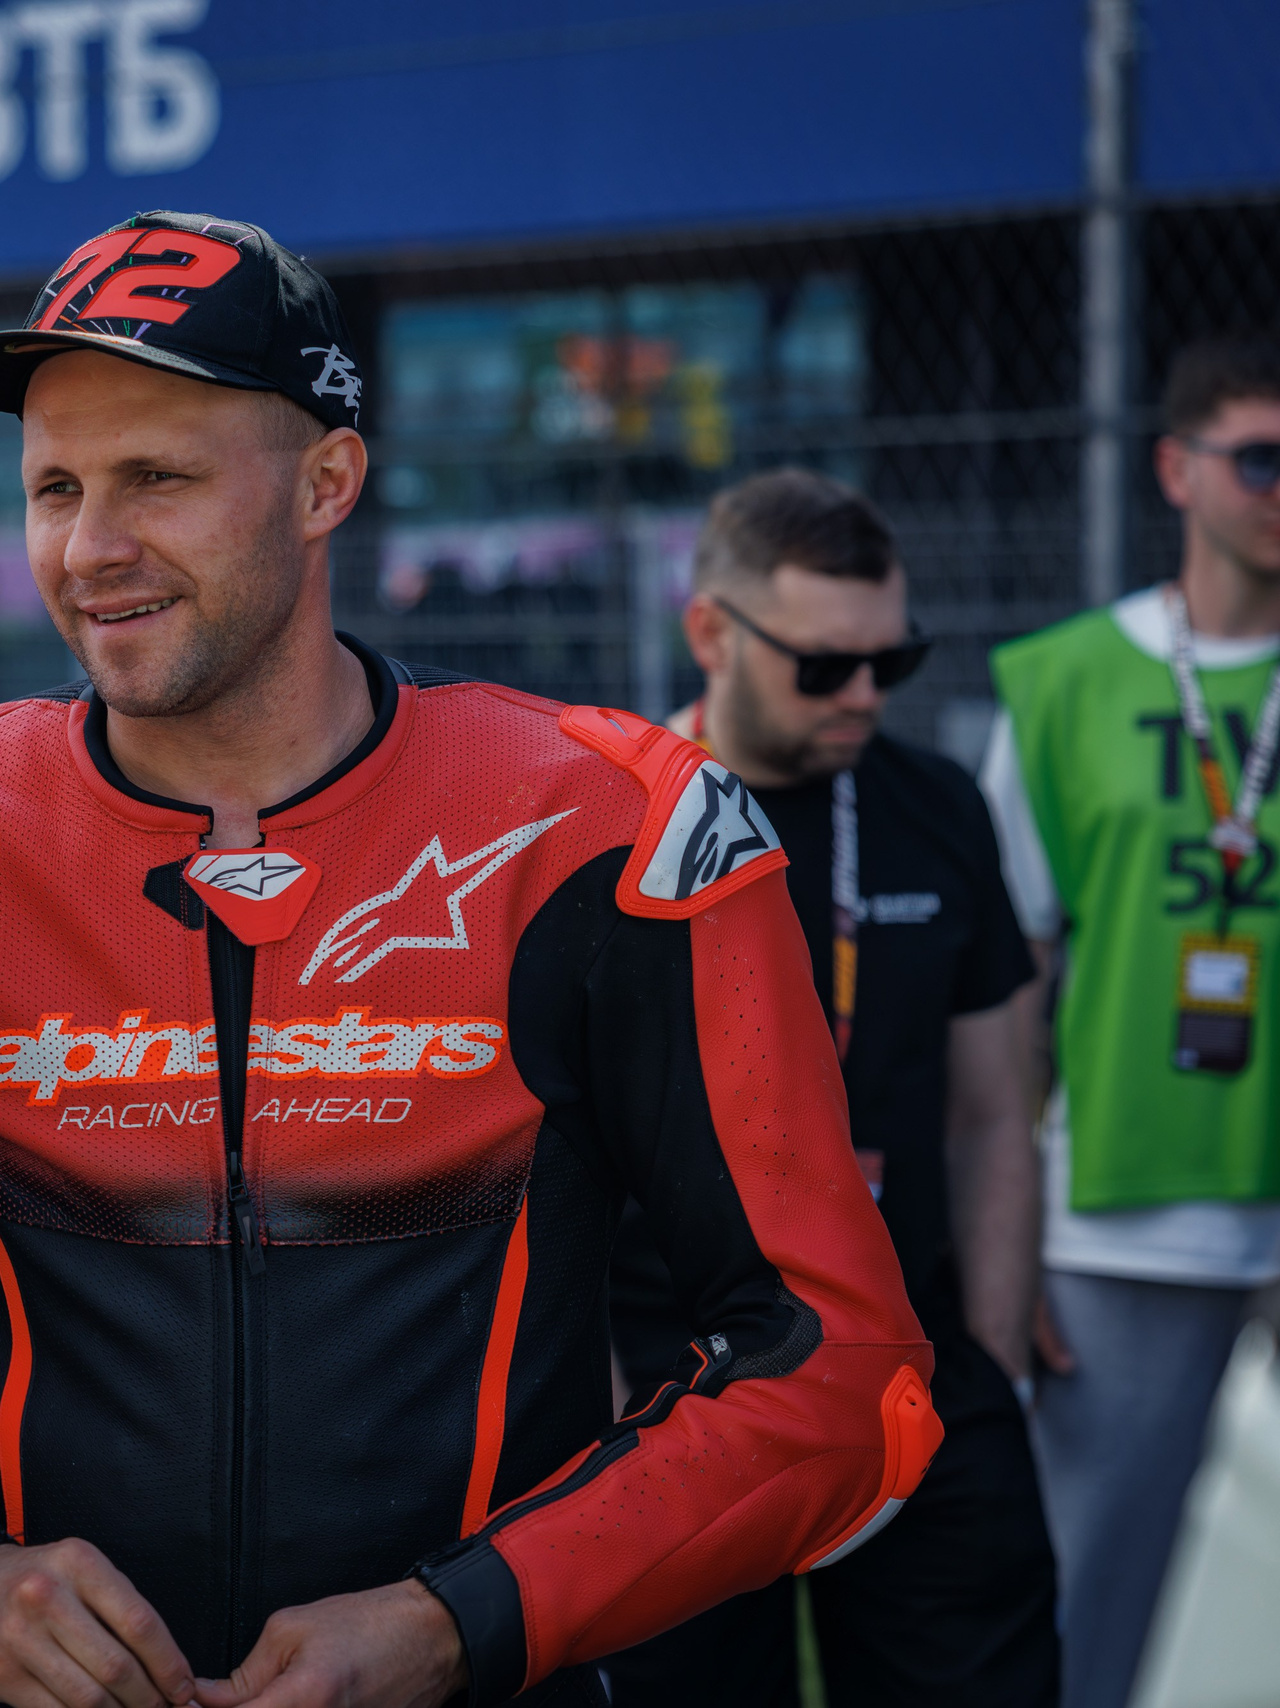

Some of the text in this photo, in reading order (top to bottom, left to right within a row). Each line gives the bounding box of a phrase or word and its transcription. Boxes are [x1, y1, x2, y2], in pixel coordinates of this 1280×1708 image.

[37, 227, 242, 331] 72
[57, 1096, 413, 1131] RACING AHEAD
